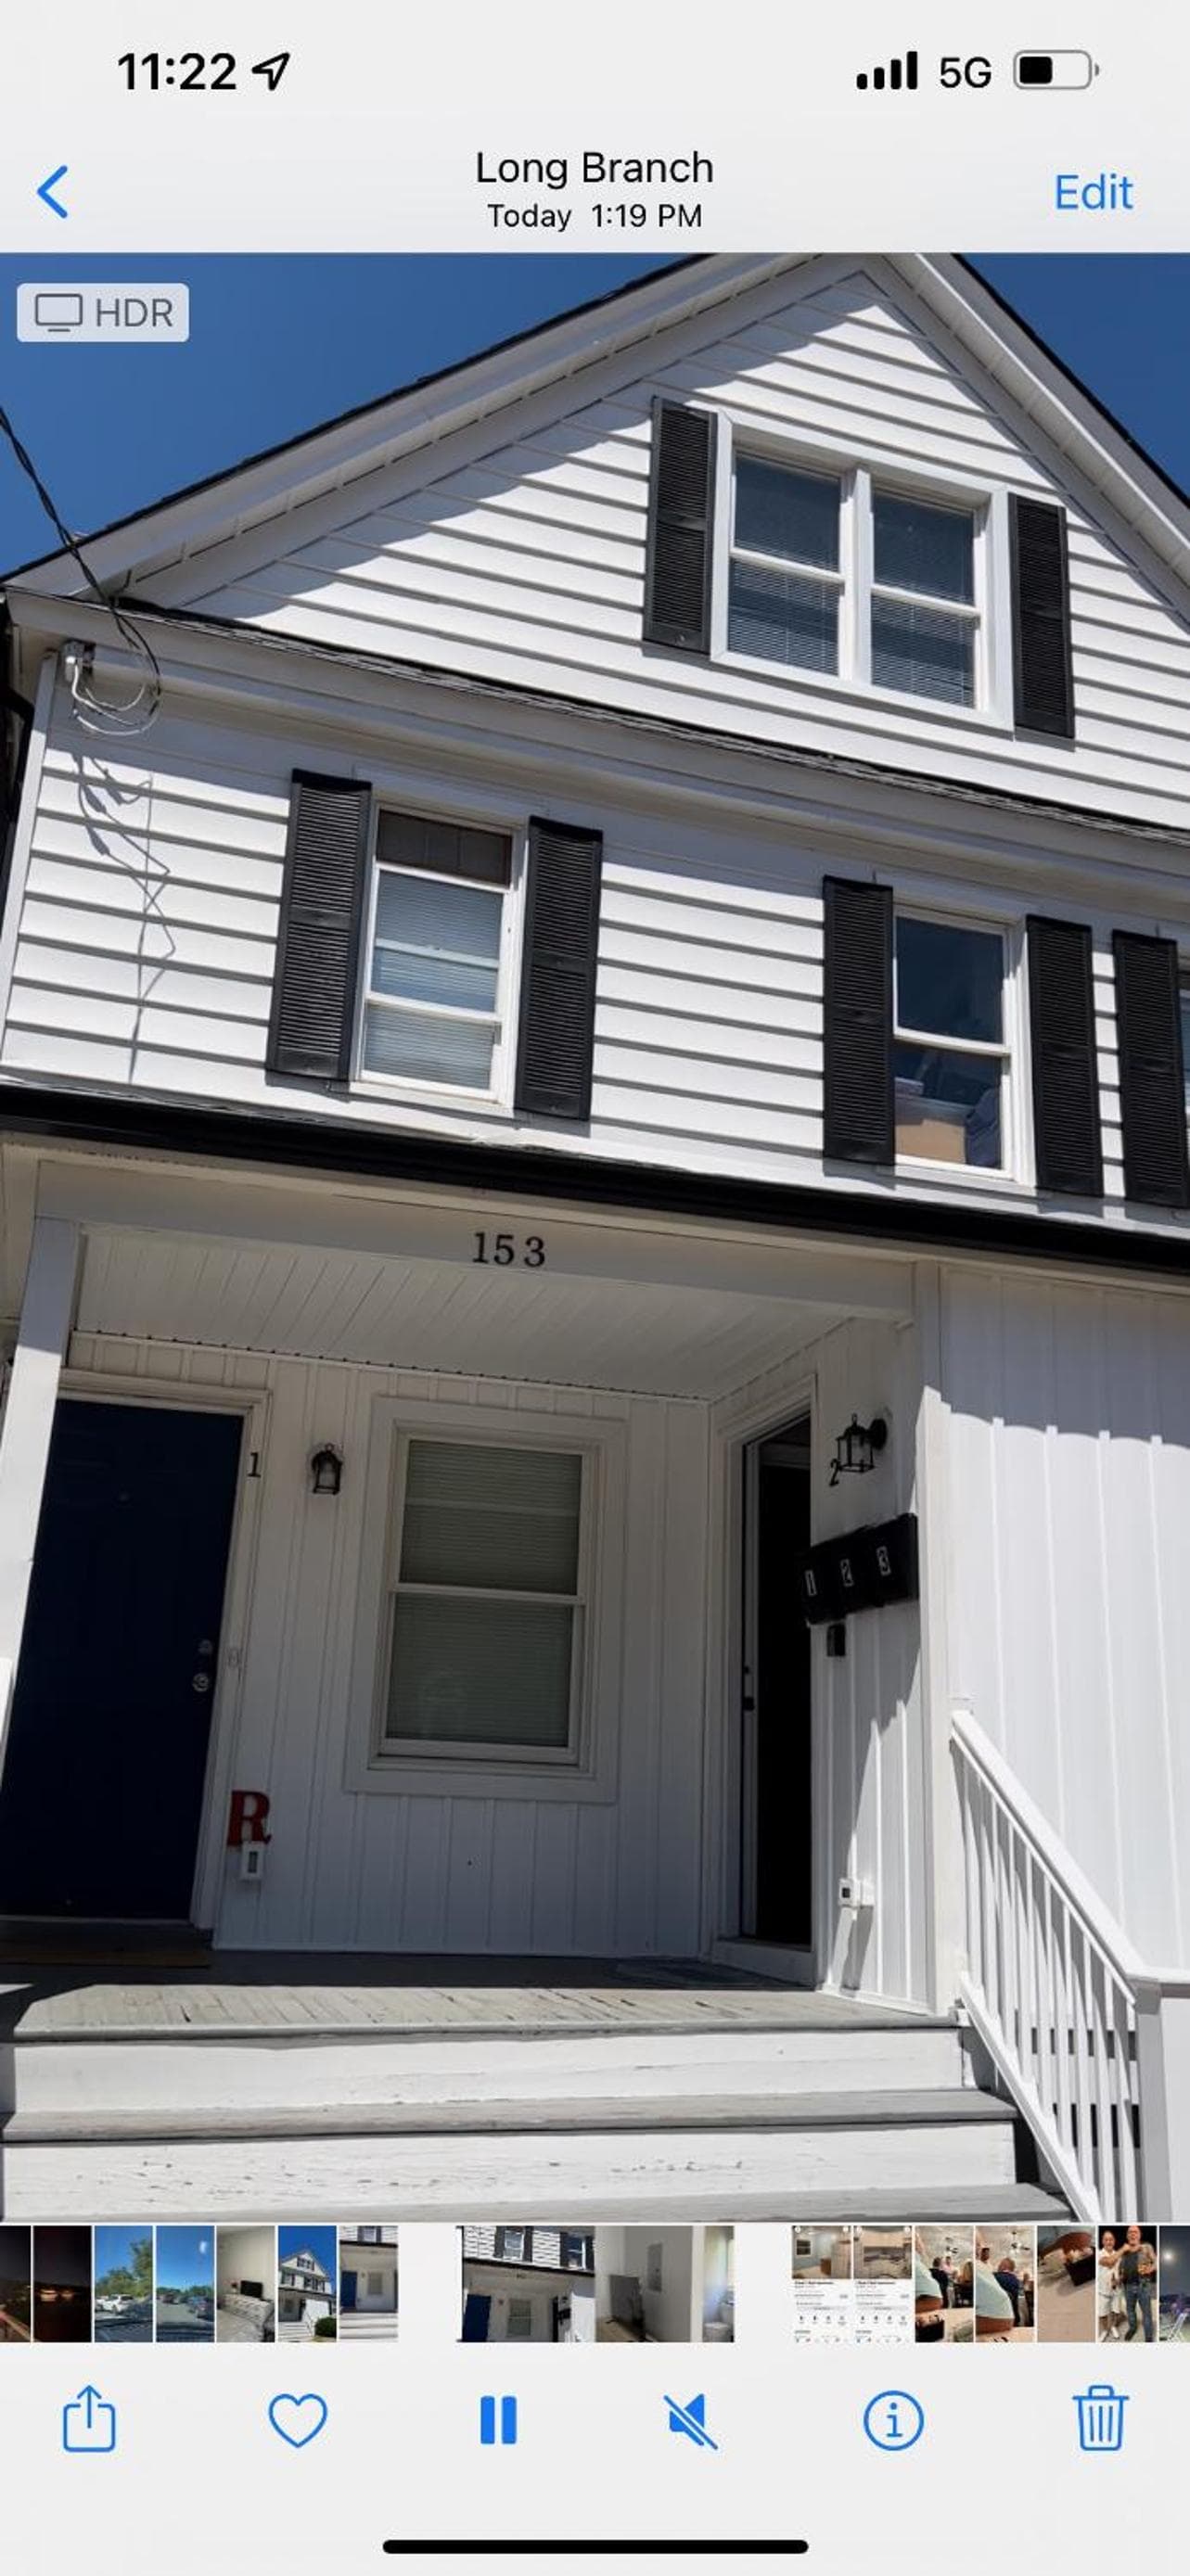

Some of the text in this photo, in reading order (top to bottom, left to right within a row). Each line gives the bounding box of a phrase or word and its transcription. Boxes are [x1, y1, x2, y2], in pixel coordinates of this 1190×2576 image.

[472, 1231, 546, 1268] 153
[247, 1451, 262, 1478] 1
[829, 1458, 839, 1486] 2
[805, 1569, 817, 1597] 1
[840, 1559, 854, 1587] 2
[227, 1789, 273, 1846] R
